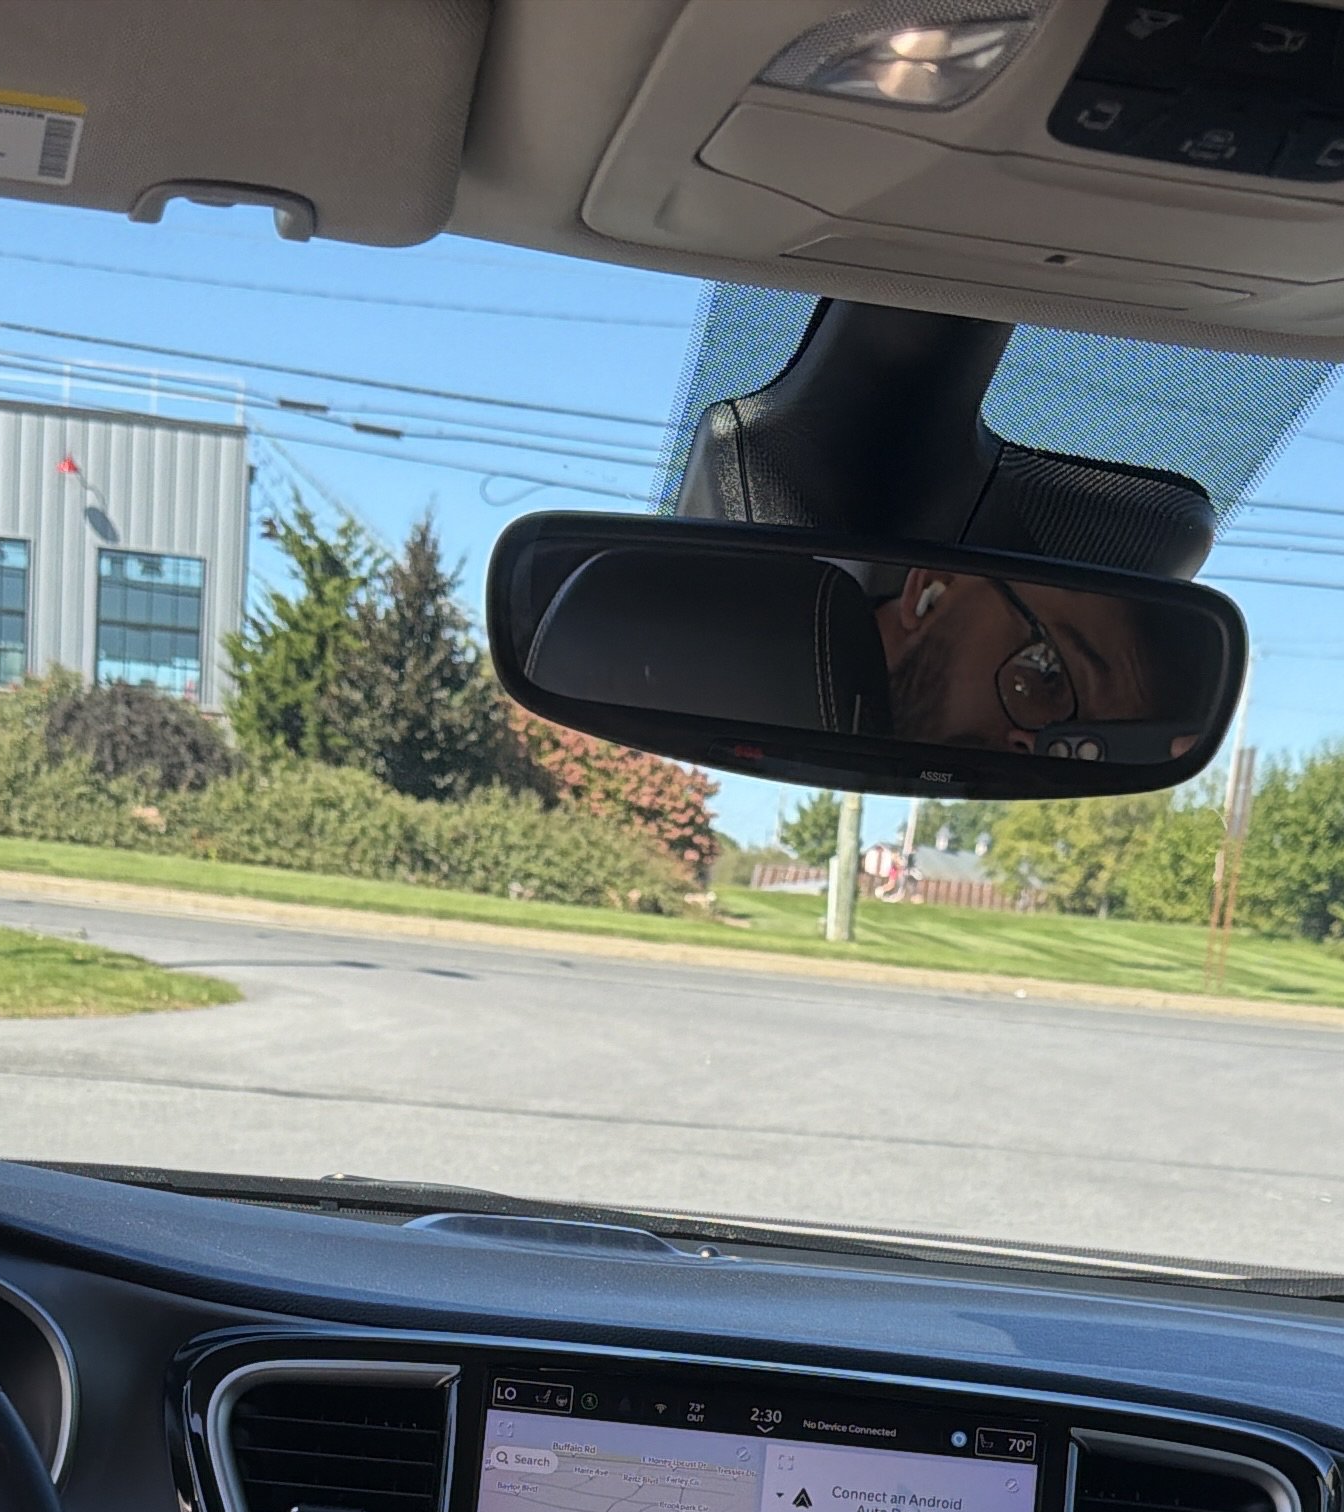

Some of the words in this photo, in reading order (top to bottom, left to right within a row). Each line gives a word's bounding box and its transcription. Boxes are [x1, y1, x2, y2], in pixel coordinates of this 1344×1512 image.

[919, 770, 953, 784] ASSIST
[496, 1387, 517, 1401] LO
[686, 1413, 705, 1423] OUT
[750, 1407, 783, 1425] 2:30
[803, 1419, 817, 1430] No
[817, 1421, 848, 1433] Device
[848, 1424, 897, 1438] Connected
[552, 1442, 583, 1453] Buffalo
[583, 1445, 596, 1454] Rd
[1008, 1438, 1033, 1453] 70°
[513, 1454, 551, 1468] Search
[831, 1485, 888, 1503] Connect
[889, 1494, 906, 1505] an
[907, 1494, 963, 1512] Android
